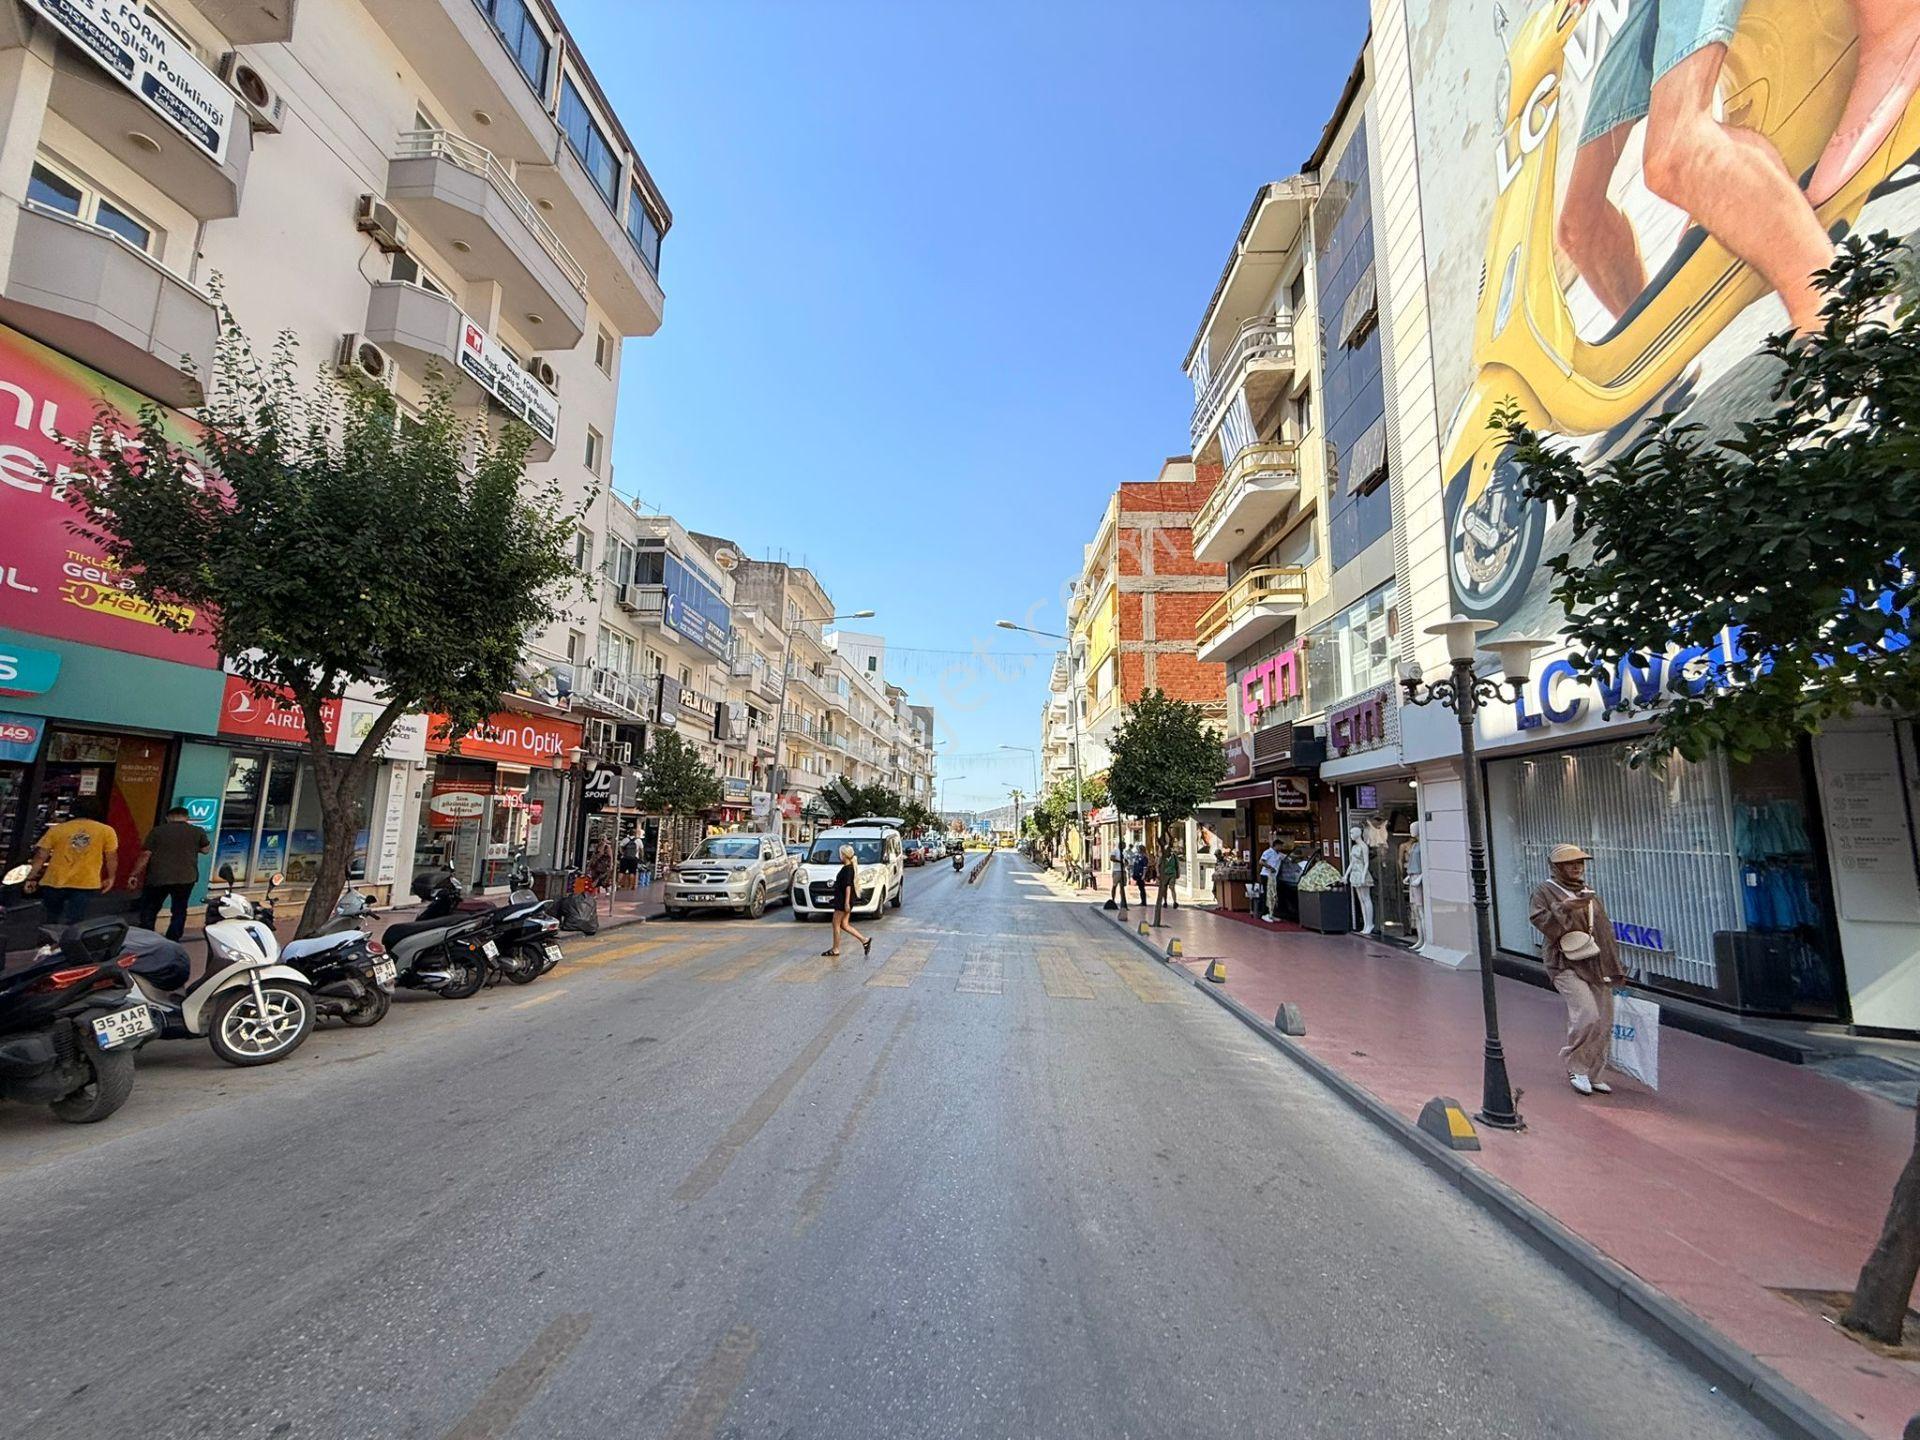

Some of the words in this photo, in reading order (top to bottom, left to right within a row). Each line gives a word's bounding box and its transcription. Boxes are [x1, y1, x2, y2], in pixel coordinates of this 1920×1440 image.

[119, 5, 166, 54] FORM
[100, 8, 153, 65] Sağlığı
[157, 61, 224, 126] Polikliniği
[1496, 74, 1559, 195] LC
[1516, 658, 1590, 732] LC
[522, 727, 563, 756] Optik
[585, 770, 615, 790] JD
[192, 805, 210, 817] W
[96, 1016, 116, 1031] 35
[120, 1007, 147, 1024] AAR
[116, 1020, 145, 1038] 332
